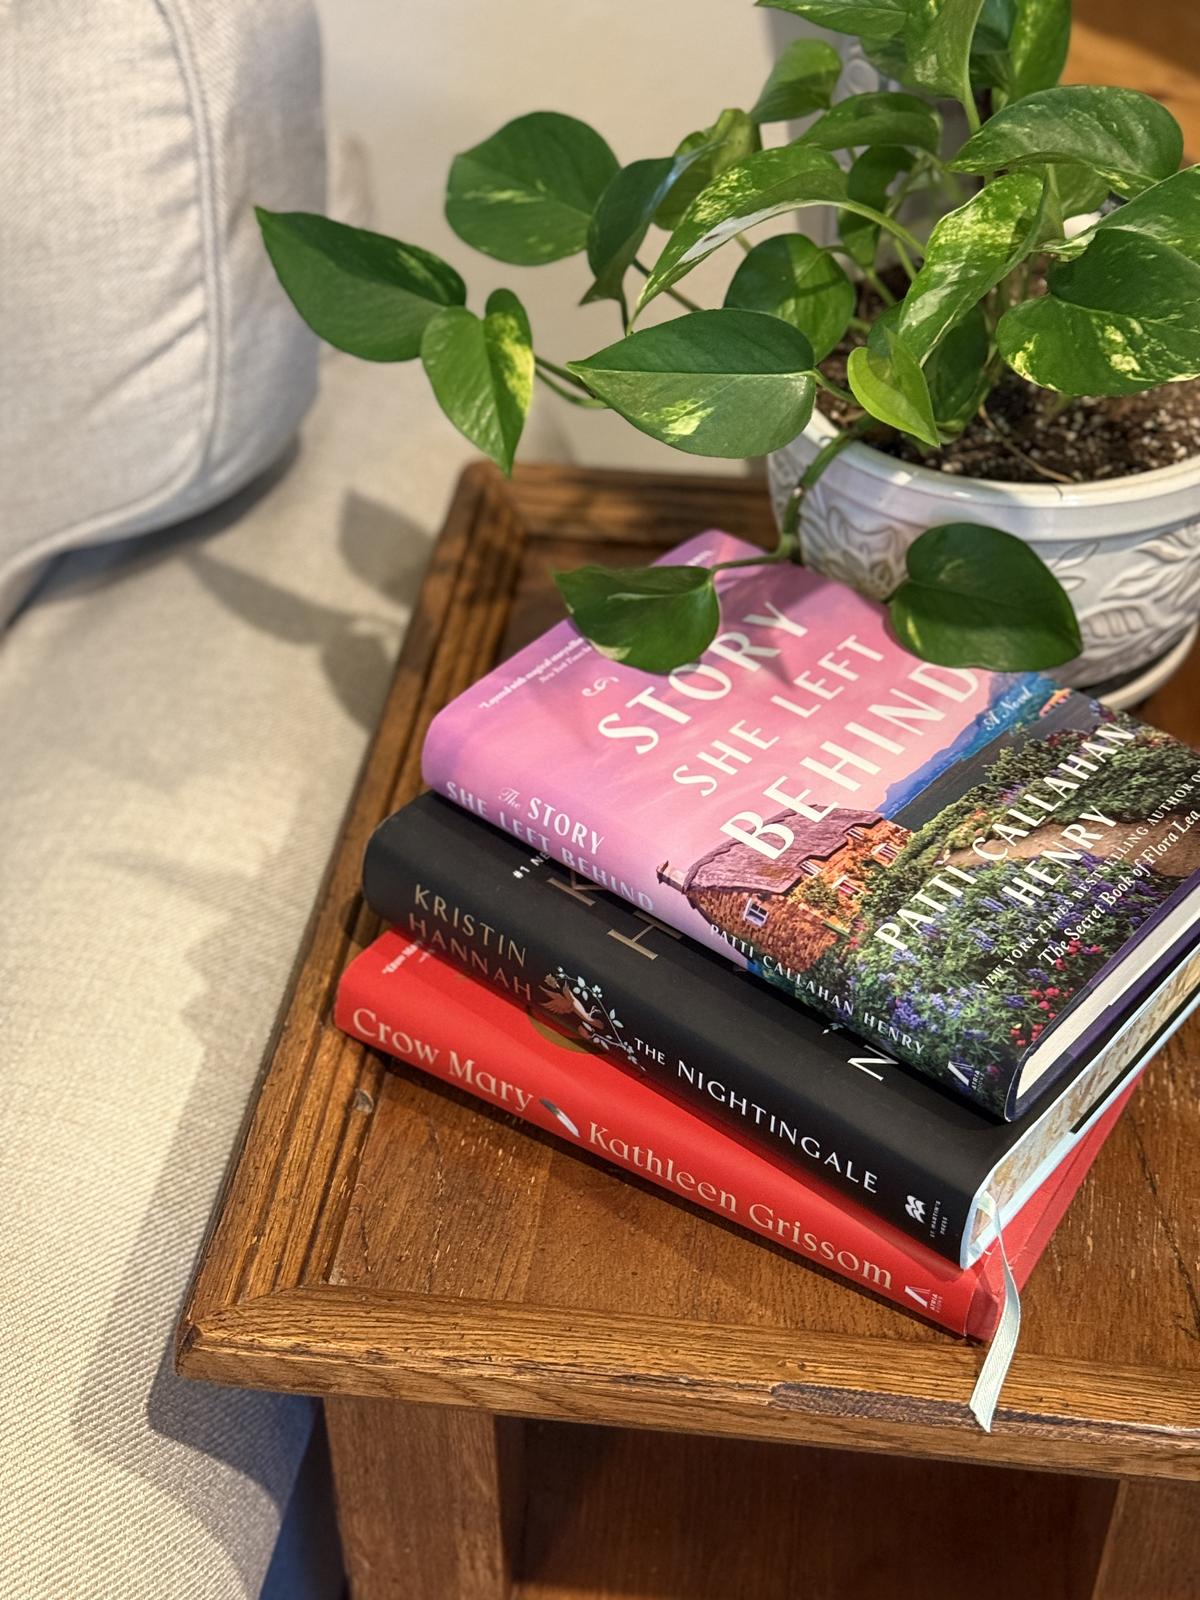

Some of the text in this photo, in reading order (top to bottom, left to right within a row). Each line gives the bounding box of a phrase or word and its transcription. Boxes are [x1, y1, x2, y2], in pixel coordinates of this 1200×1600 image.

[598, 601, 808, 754] STORY
[672, 634, 884, 797] SHE LEFT
[1000, 685, 1033, 719] Novel
[498, 787, 604, 854] The STORY
[720, 665, 978, 861] BEHIND
[446, 781, 488, 818] SHE
[500, 811, 550, 852] LEFT
[561, 847, 655, 911] BEHIND
[513, 851, 550, 879] #1 NE
[874, 723, 1135, 951] PATTI CALLAHAN
[977, 769, 1200, 993] NEW YORK TIMES BESTSELLING AUTHOR O
[1002, 805, 1117, 906] HENRY
[1038, 810, 1200, 966] The Secret Book of Flora Lea
[409, 913, 531, 1000] HANNAH
[414, 884, 527, 967] KRISTIN
[710, 924, 754, 958] PATTI
[763, 955, 854, 1016] CALLAHAN
[864, 1012, 925, 1055] HENRY
[353, 1008, 893, 1290] Crow Mary Kathleen Grissom
[634, 1037, 666, 1065] THE
[677, 1060, 879, 1194] NIGHTINGALE
